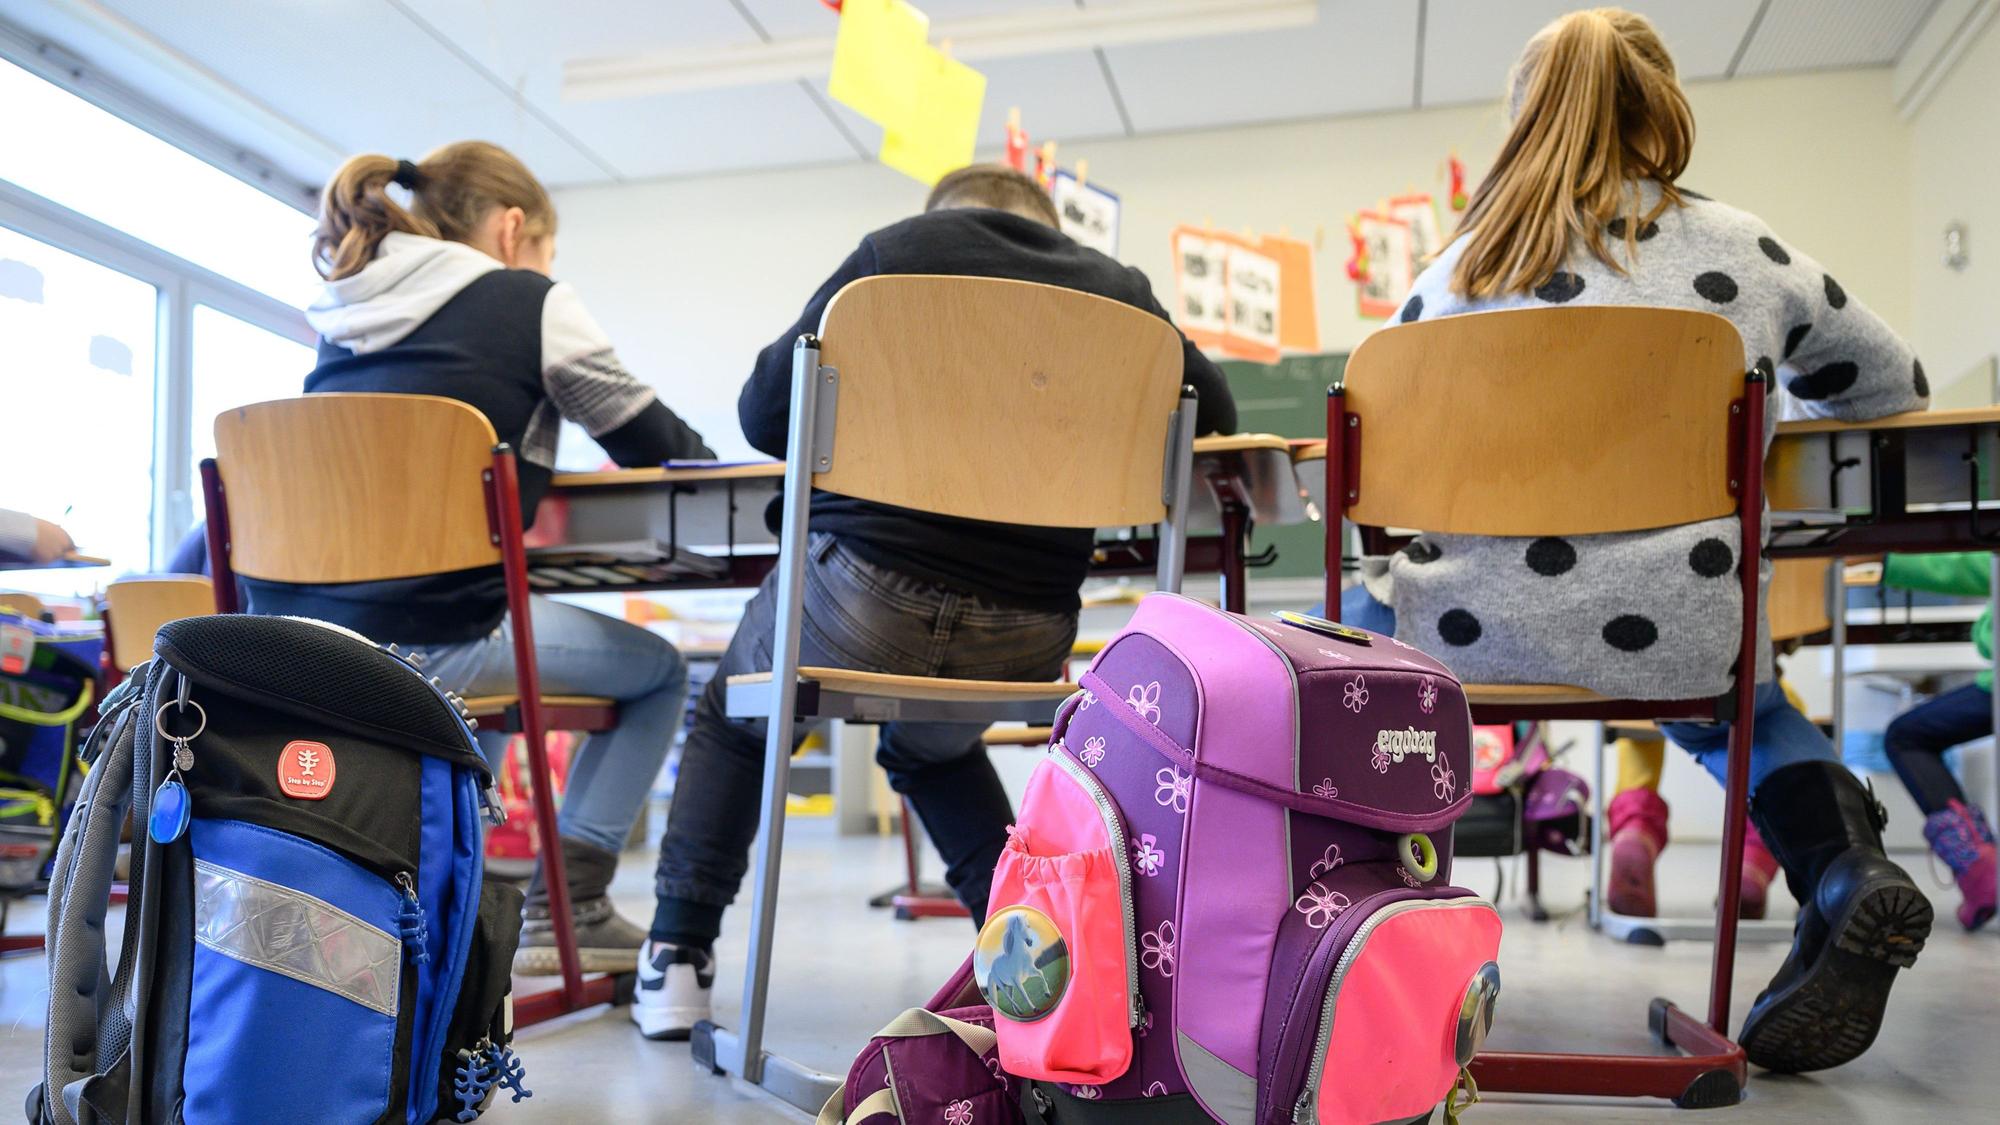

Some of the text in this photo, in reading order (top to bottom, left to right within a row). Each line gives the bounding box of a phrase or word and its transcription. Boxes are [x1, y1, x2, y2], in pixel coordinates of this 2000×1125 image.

[1377, 725, 1437, 763] ergobag
[287, 777, 302, 785] Step
[302, 778, 311, 786] by
